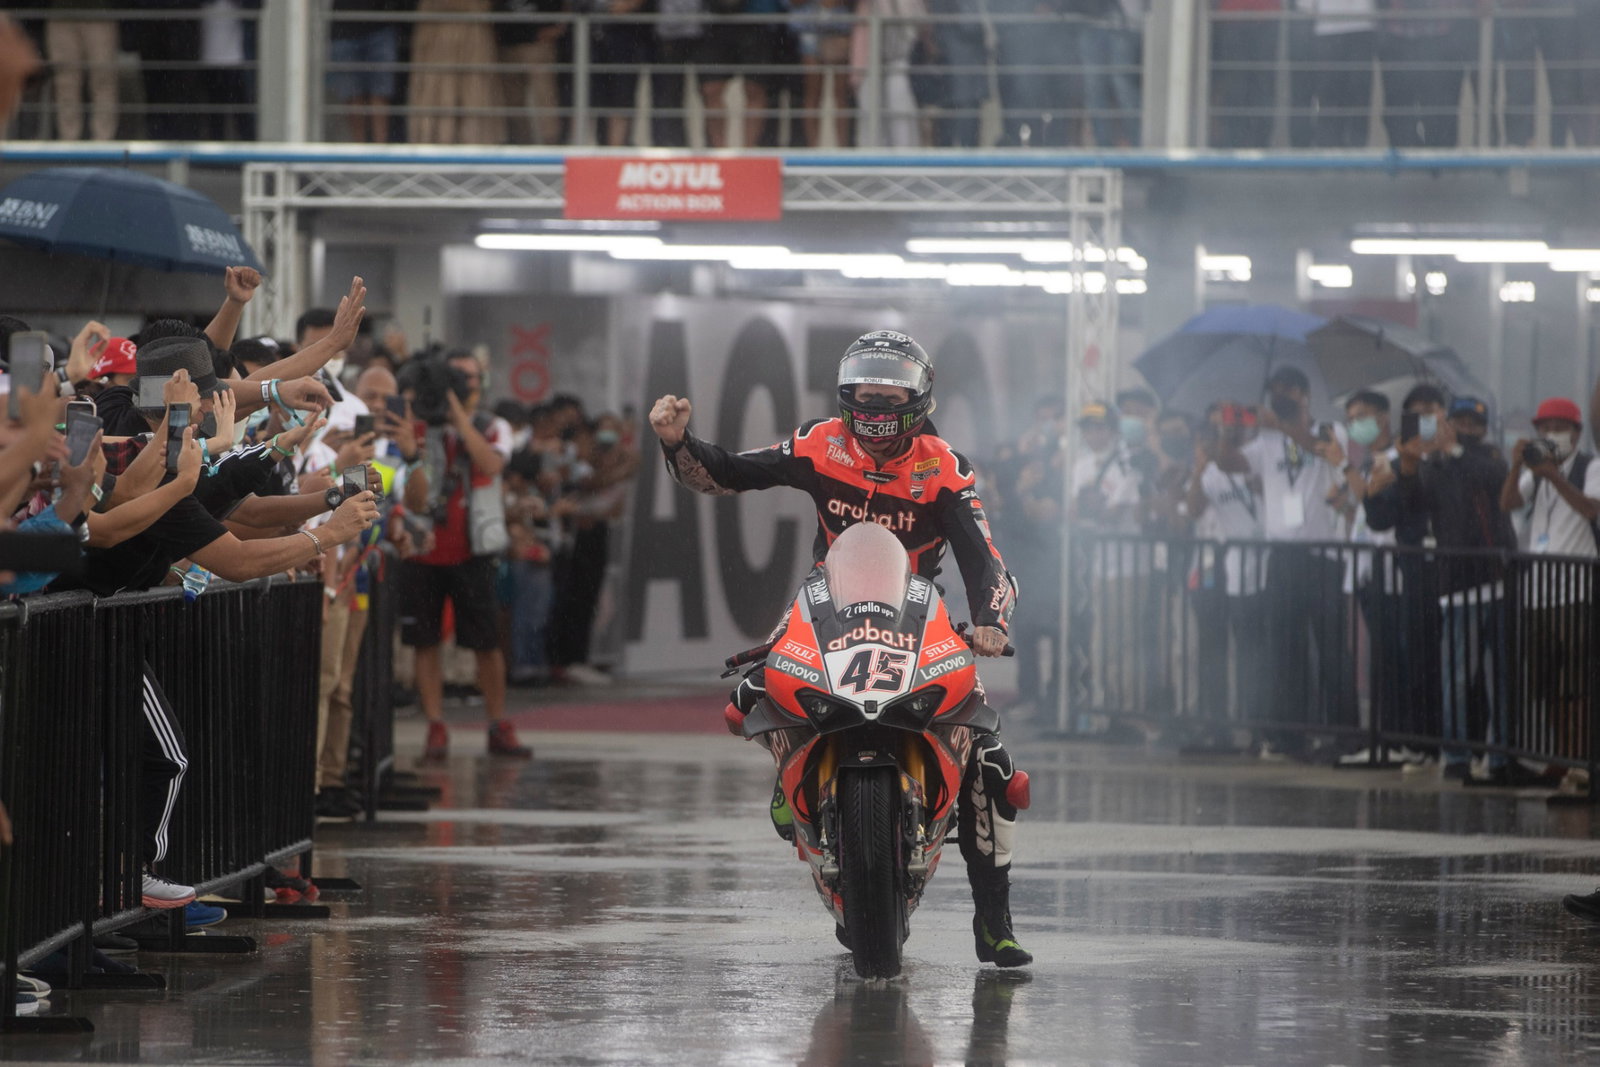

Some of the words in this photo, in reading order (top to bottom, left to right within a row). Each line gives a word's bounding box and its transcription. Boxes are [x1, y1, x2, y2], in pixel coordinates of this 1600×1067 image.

[619, 162, 724, 189] MOTUL
[616, 194, 681, 211] ACTION
[687, 194, 724, 211] BOX
[862, 352, 899, 361] SHARK
[855, 422, 897, 436] Muc-Off
[907, 577, 928, 605] FIAMM
[854, 601, 880, 614] riello
[881, 607, 894, 617] ups
[827, 618, 918, 651] aruba.it
[775, 656, 820, 683] Lenovo
[838, 648, 910, 695] 45
[920, 655, 967, 681] Lenovo
